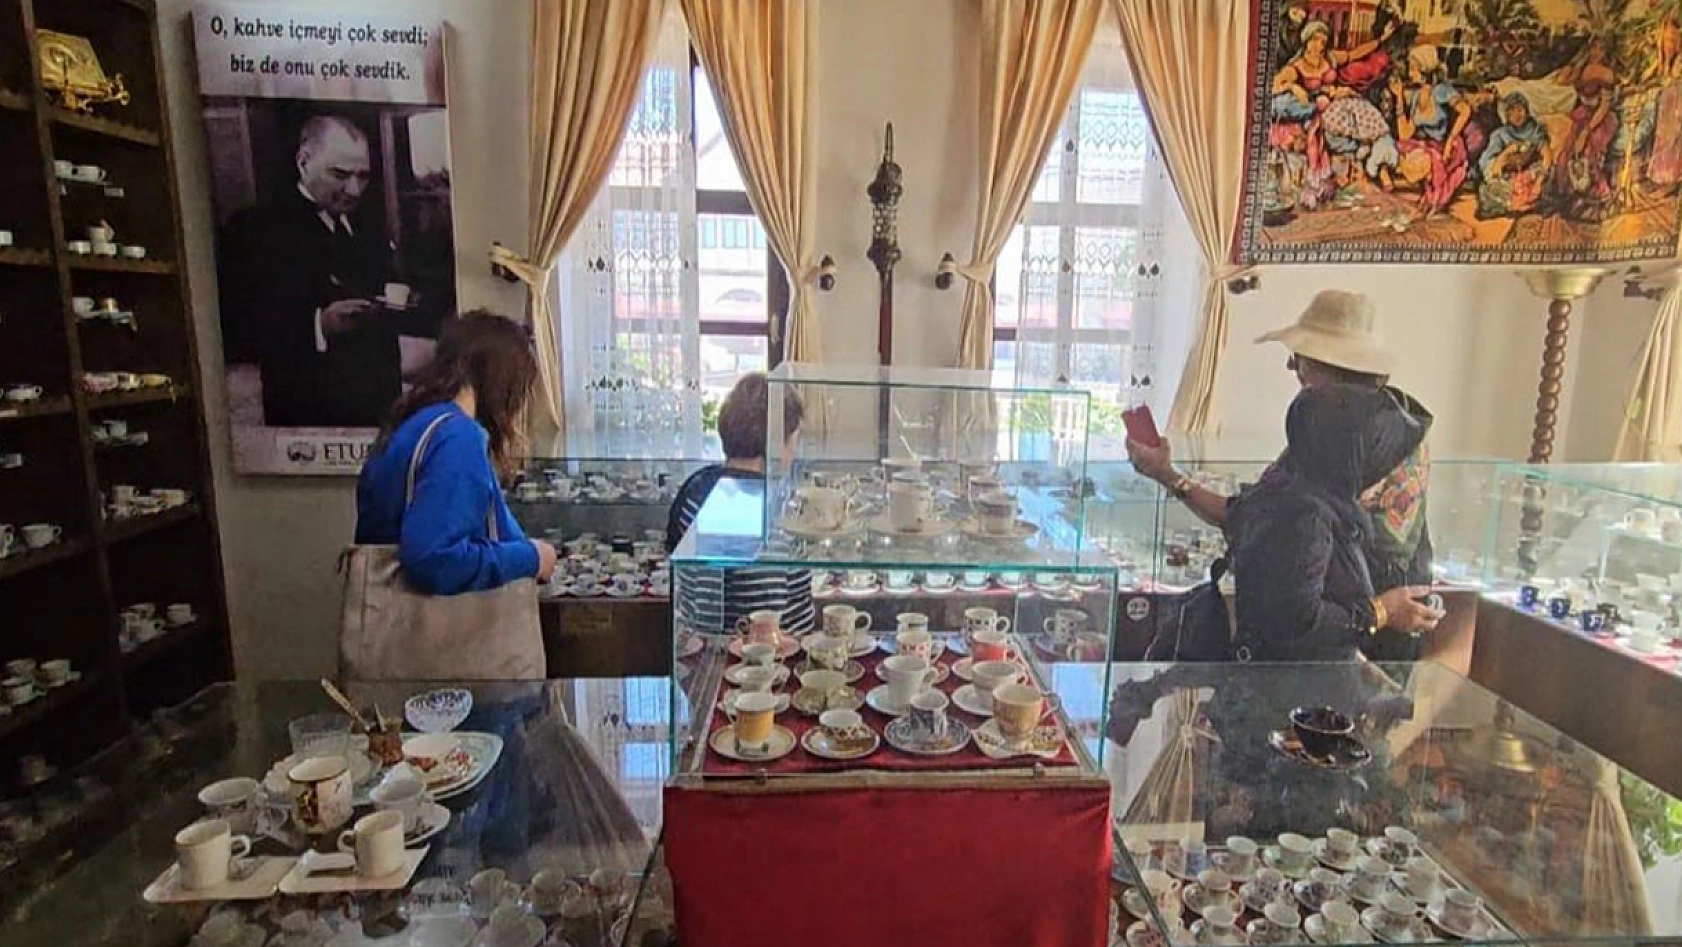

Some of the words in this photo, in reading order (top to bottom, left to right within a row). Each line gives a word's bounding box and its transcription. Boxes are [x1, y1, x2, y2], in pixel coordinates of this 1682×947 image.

[211, 16, 229, 39] O,
[234, 17, 284, 38] kahve
[289, 19, 343, 45] içmeyi
[347, 23, 377, 43] çok
[382, 26, 428, 47] sevdi;
[230, 54, 254, 73] biz
[259, 55, 279, 73] de
[284, 60, 315, 76] onu
[320, 59, 349, 81] çok
[354, 62, 410, 81] sevdik.
